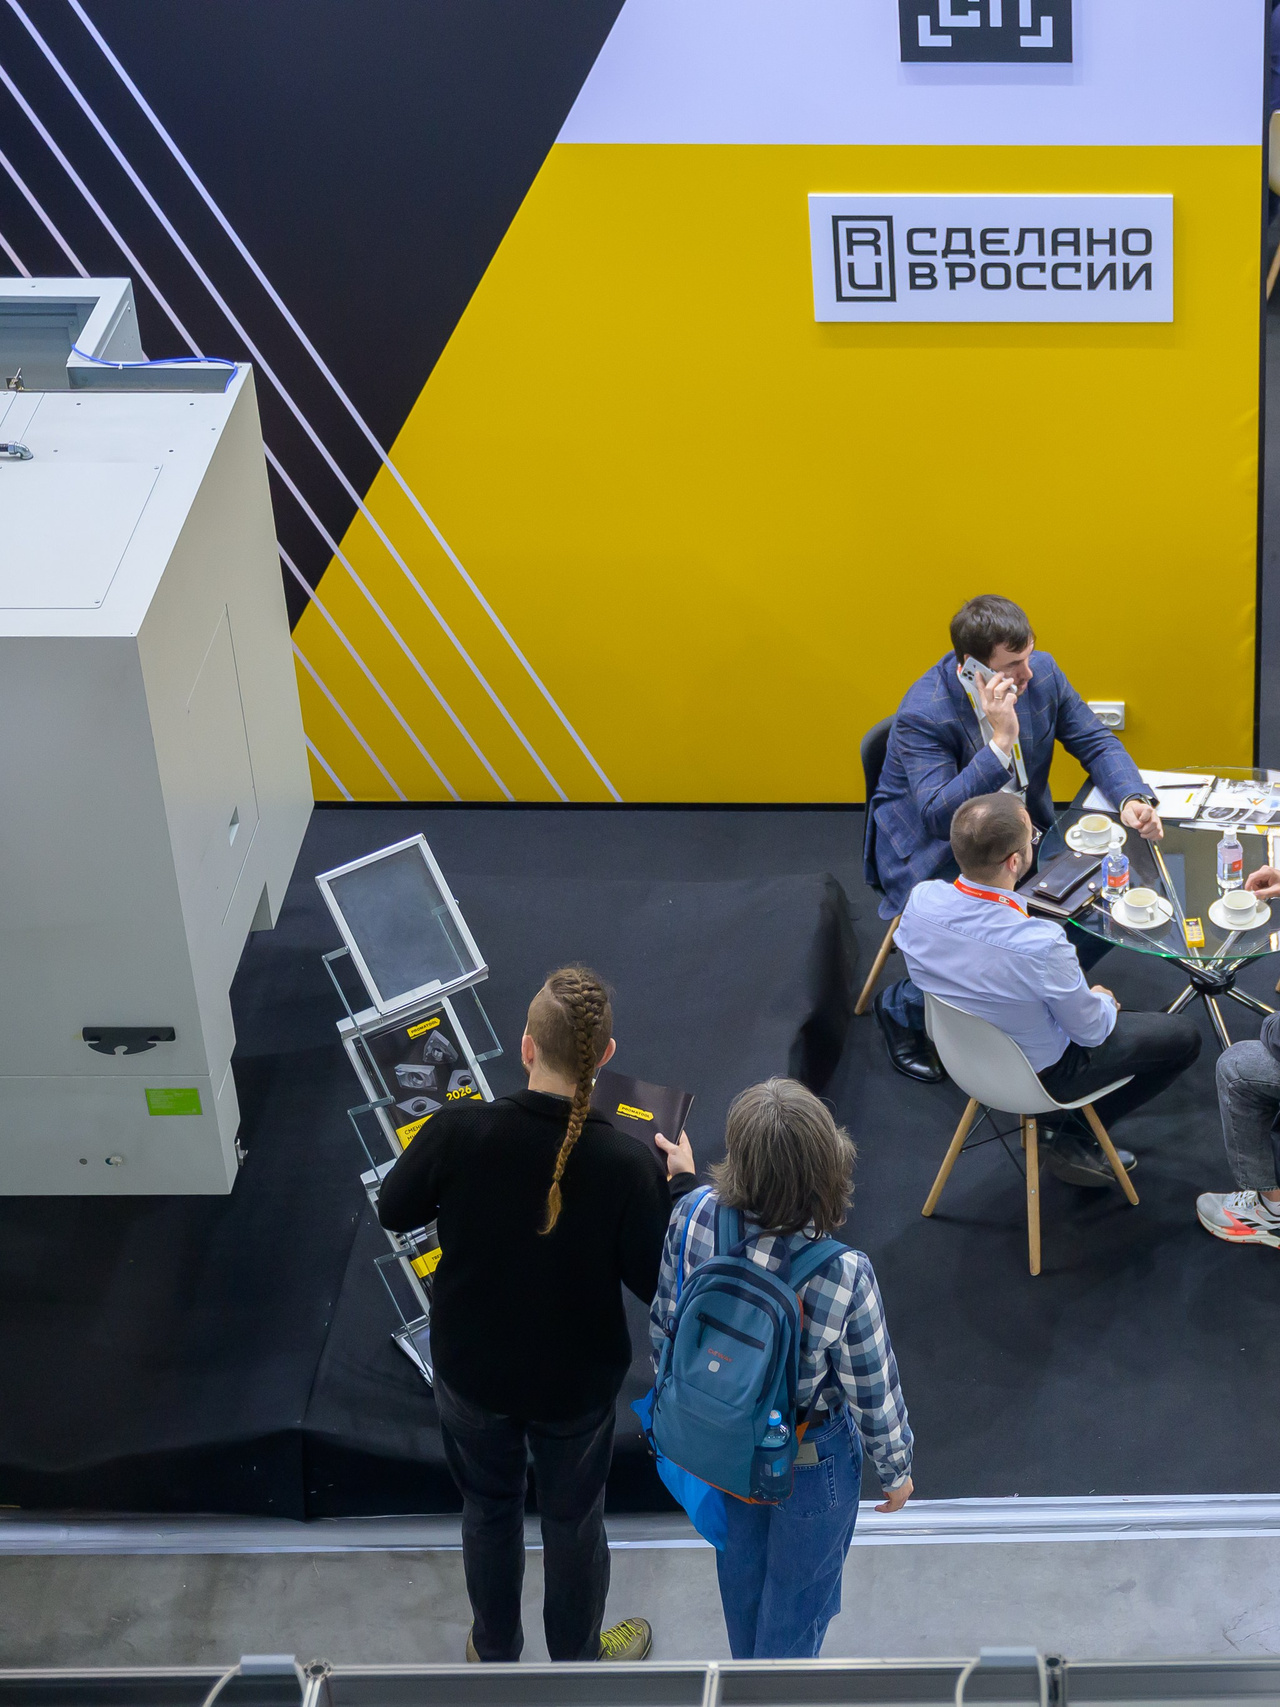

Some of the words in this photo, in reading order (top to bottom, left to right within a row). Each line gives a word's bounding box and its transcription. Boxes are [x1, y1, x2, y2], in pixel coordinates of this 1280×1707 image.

[906, 227, 1153, 260] СДЕЛАНО
[908, 262, 938, 291] В
[944, 262, 1153, 291] РОССИИ
[445, 1085, 472, 1101] 2026
